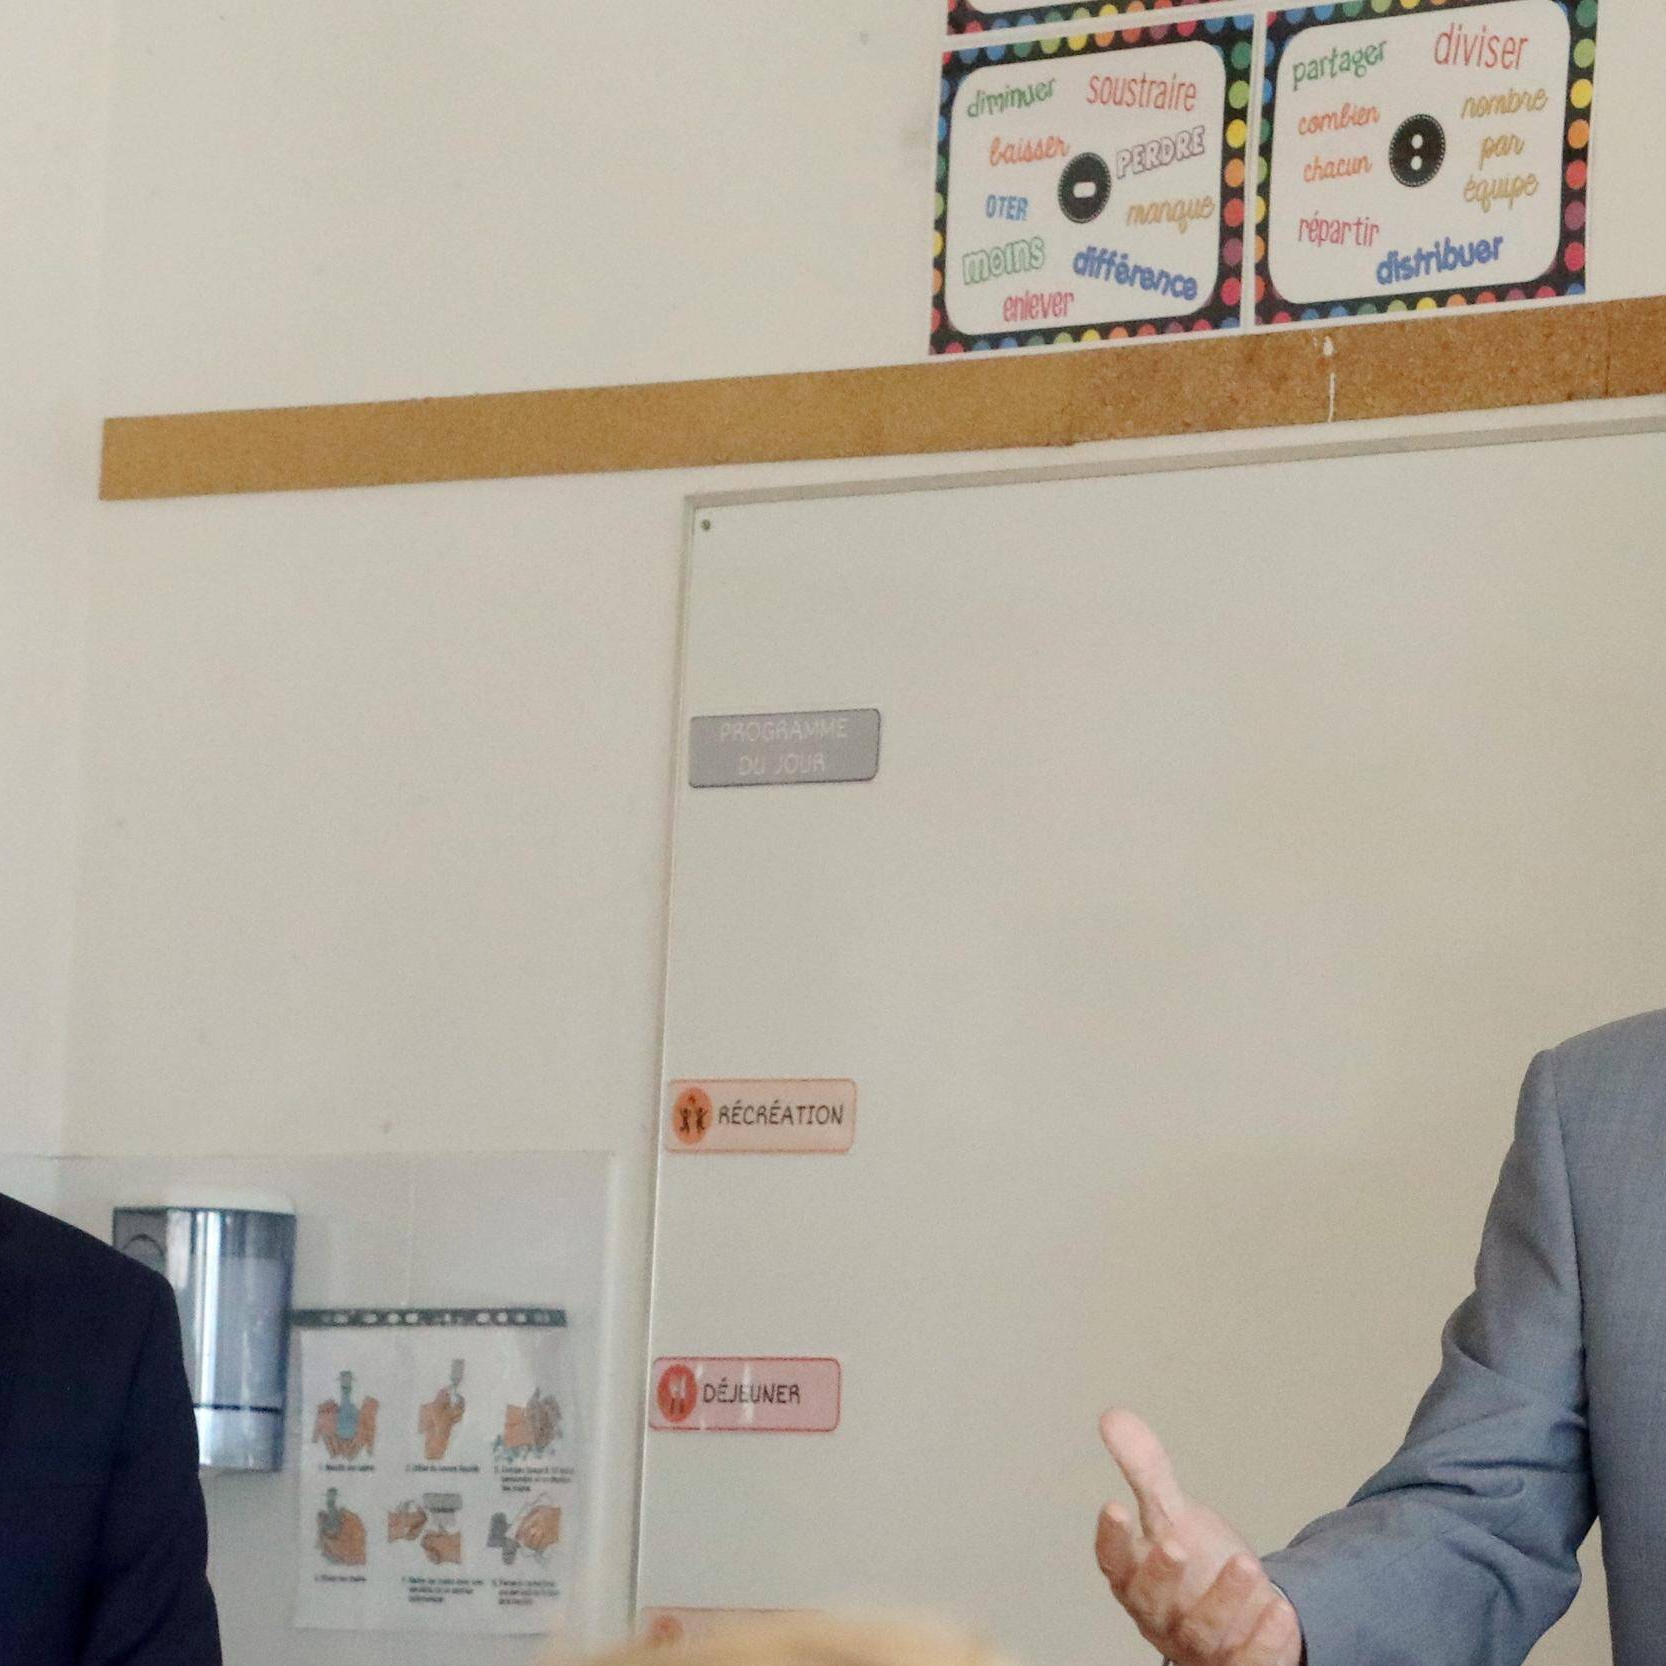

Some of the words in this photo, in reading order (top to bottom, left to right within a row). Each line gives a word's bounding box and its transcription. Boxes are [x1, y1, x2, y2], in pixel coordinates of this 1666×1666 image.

[1434, 22, 1529, 70] diviser
[1292, 39, 1387, 91] partager
[967, 78, 1056, 118] diminuer
[1086, 73, 1197, 111] soustraire
[1460, 88, 1548, 120] nombre
[1298, 102, 1381, 135] combien
[989, 136, 1070, 167] baisser
[1116, 125, 1205, 179] PERDRE
[1303, 154, 1373, 183] chacun
[1479, 134, 1524, 170] par
[1464, 172, 1539, 213] équipe
[1127, 196, 1215, 234] manque
[1298, 210, 1380, 247] répartir
[962, 236, 1045, 285] moins
[1072, 246, 1198, 300] différence
[1376, 236, 1504, 285] distribuer
[1002, 289, 1075, 322] enlever
[719, 717, 849, 743] PROGRAMME
[738, 755, 766, 777] DU
[773, 753, 825, 776] JOUR
[718, 1100, 844, 1126] RÉCRÉATION
[703, 1376, 801, 1404] DÉJEUNER
